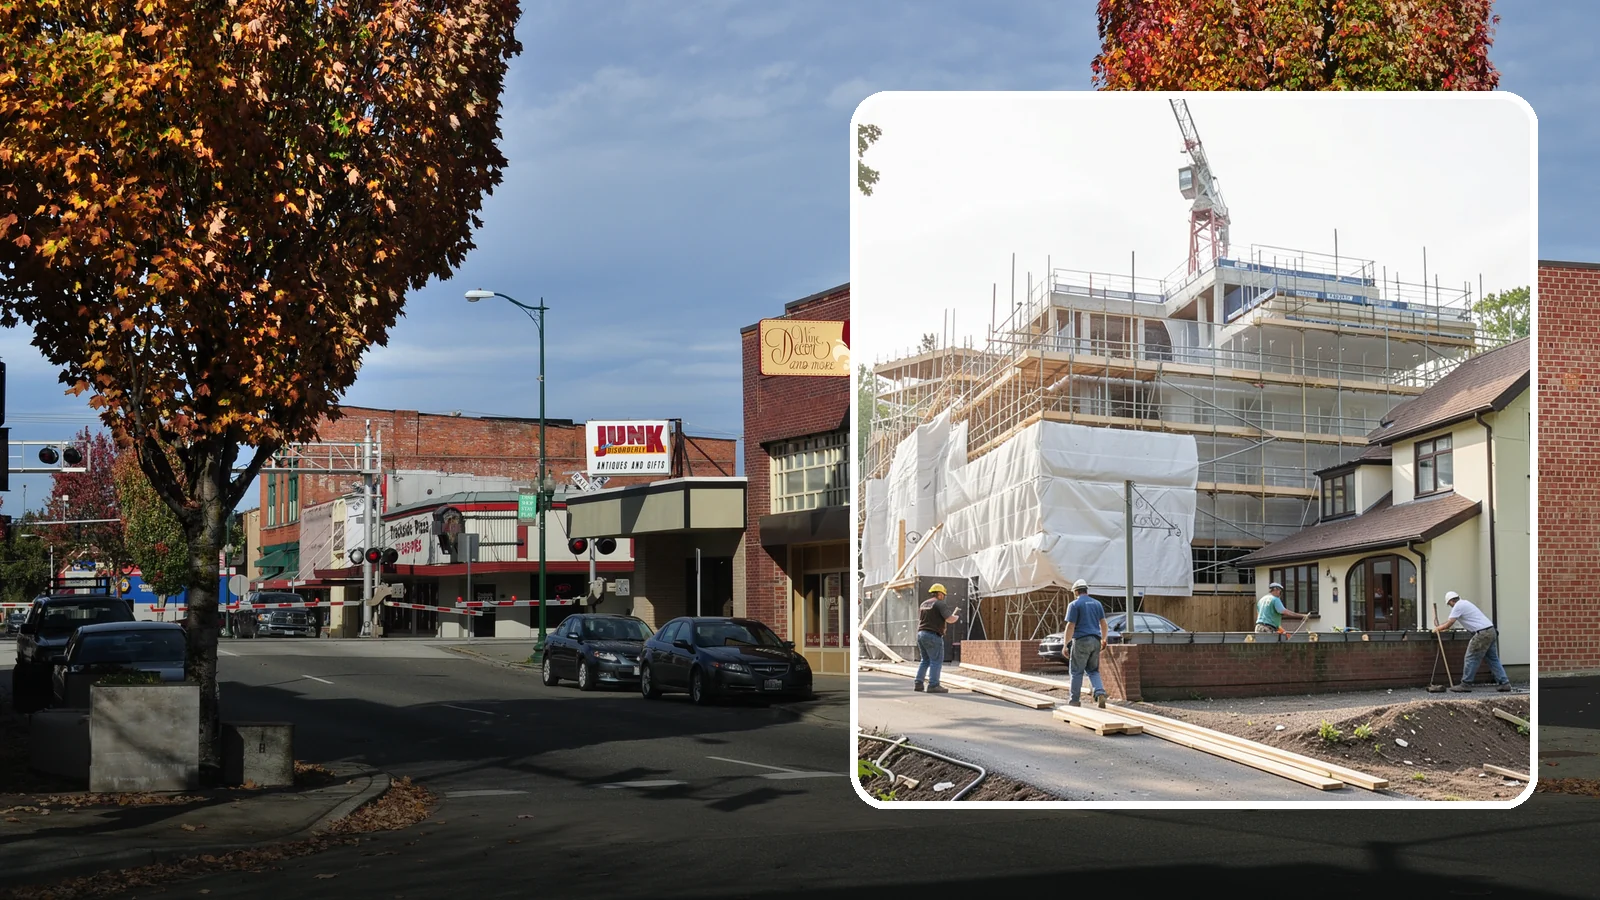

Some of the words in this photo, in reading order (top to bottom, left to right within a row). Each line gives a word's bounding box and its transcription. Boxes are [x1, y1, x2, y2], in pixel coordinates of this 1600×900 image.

[595, 425, 664, 457] JUNK
[607, 446, 646, 454] DISORDERLY
[597, 461, 628, 470] ANTIQUES
[631, 461, 644, 470] AND
[647, 460, 665, 470] GIFTS
[414, 519, 429, 534] Pizza
